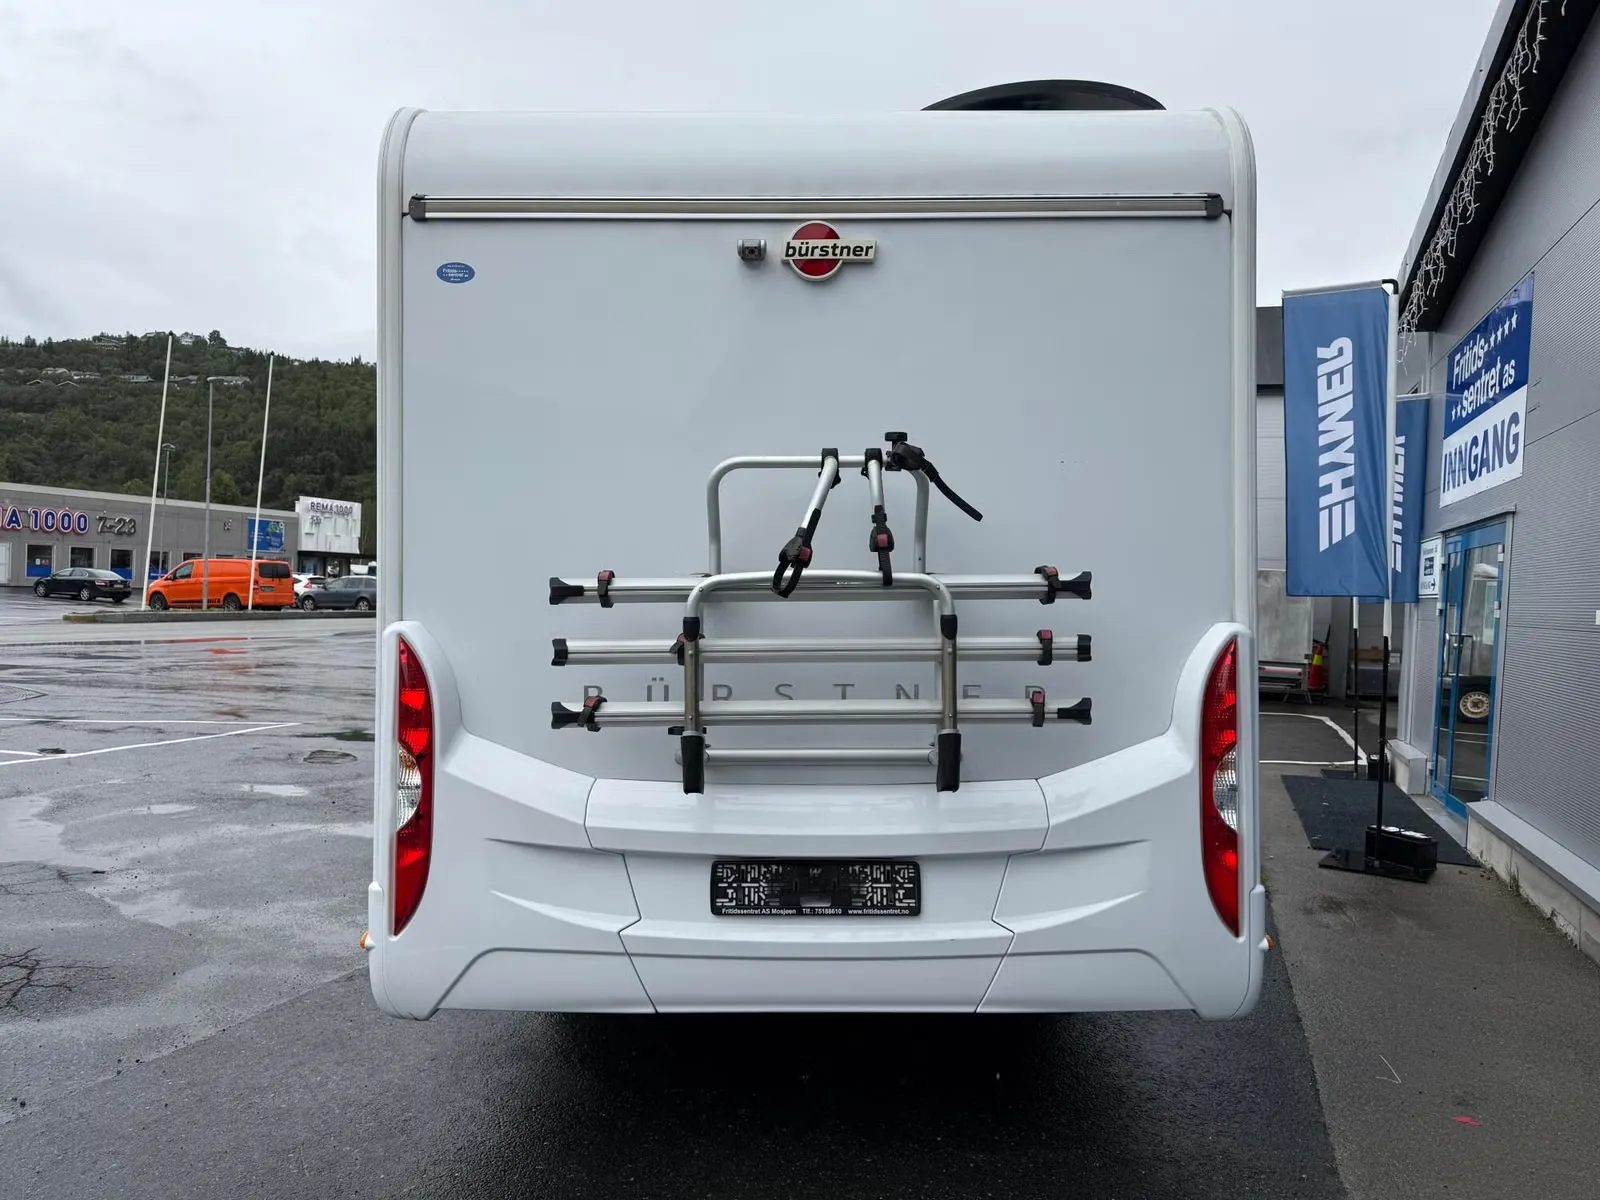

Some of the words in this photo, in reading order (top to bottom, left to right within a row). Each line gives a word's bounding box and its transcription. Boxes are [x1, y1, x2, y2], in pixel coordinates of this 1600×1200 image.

[785, 241, 874, 258] bürstner
[1452, 334, 1489, 390] Fritids-
[1461, 358, 1501, 418] sentret
[1502, 358, 1516, 387] as
[1442, 411, 1520, 494] INNGANG
[0, 505, 23, 532] A
[28, 507, 89, 535] 1000
[96, 516, 137, 535] 7-23
[310, 501, 334, 512] REMA
[335, 504, 353, 515] 1000
